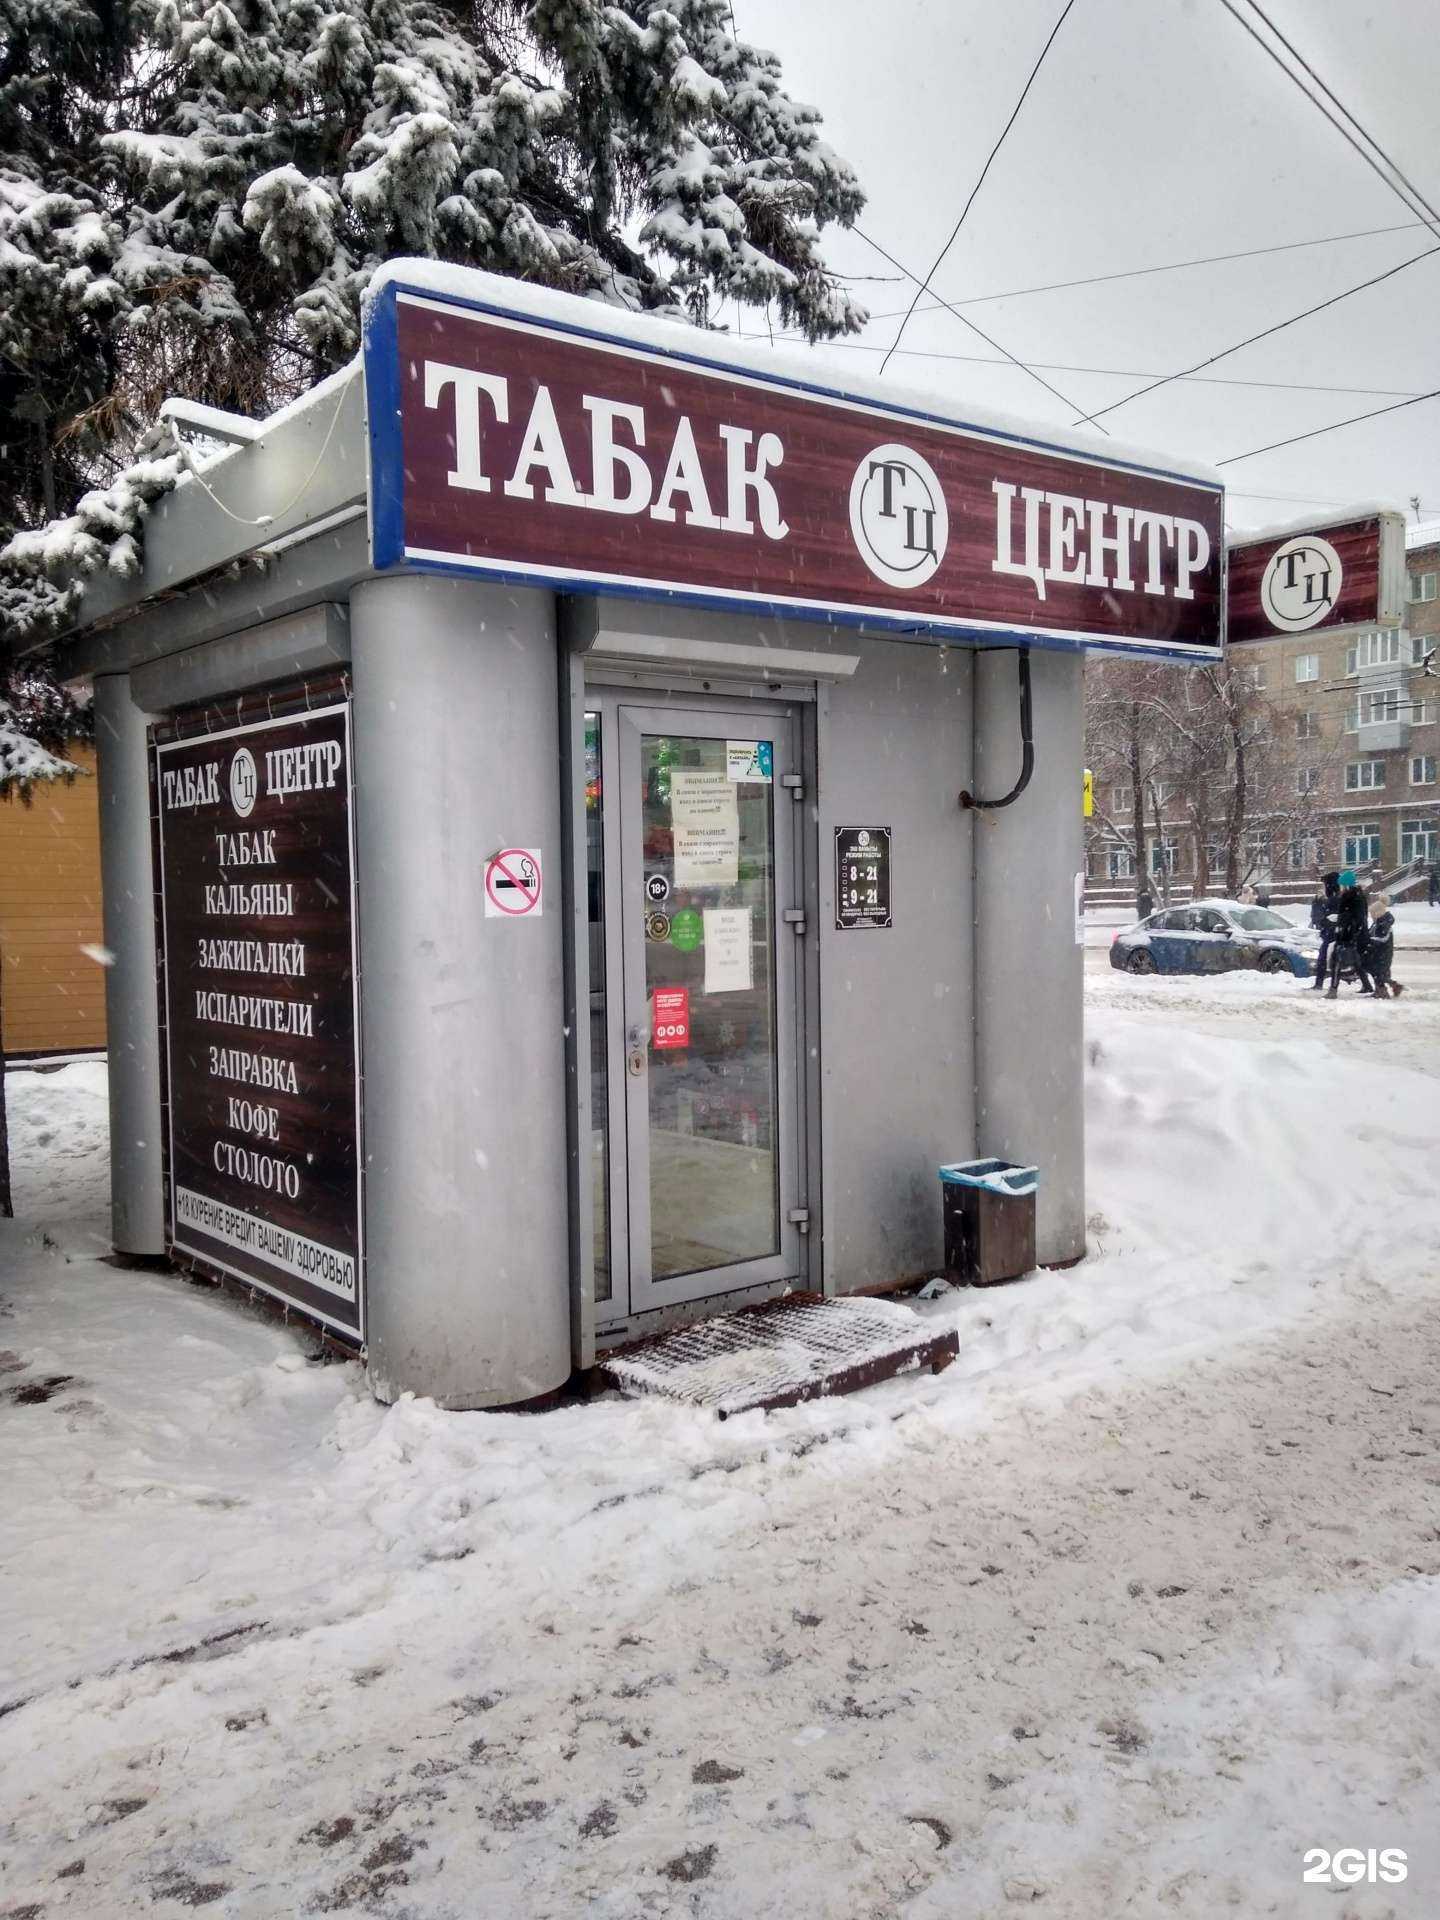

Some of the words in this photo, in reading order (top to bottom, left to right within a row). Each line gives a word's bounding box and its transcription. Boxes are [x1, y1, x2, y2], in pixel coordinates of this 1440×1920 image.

[424, 360, 790, 540] ТАБАК
[868, 460, 938, 565] ТЦ
[991, 477, 1210, 600] ЦЕНТР
[1276, 550, 1332, 607] ТЦ
[163, 762, 220, 810] ТАБАК
[265, 740, 342, 804] ЦЕНТР
[216, 829, 277, 866] ТАБАК
[650, 877, 666, 895] 18+
[850, 866, 858, 882] 8
[866, 866, 878, 881] 21
[850, 889, 858, 905] 9
[866, 889, 878, 904] 21
[205, 883, 294, 916] КАЛЬЯНЫ
[199, 939, 306, 977] ЗАЖИГАЛКИ
[196, 990, 314, 1037] ИСПАРИТЕЛИ
[209, 1046, 299, 1095] ЗАПРАВКА
[228, 1096, 280, 1142] КОФЕ
[214, 1140, 300, 1199] СТОЛОТО
[190, 1197, 224, 1232] КУРЕНИЕ
[225, 1210, 257, 1248] ВРЕДИТ
[258, 1224, 295, 1264] ВАШЕМУ
[297, 1240, 353, 1290] ЗДОРОВЬЮ
